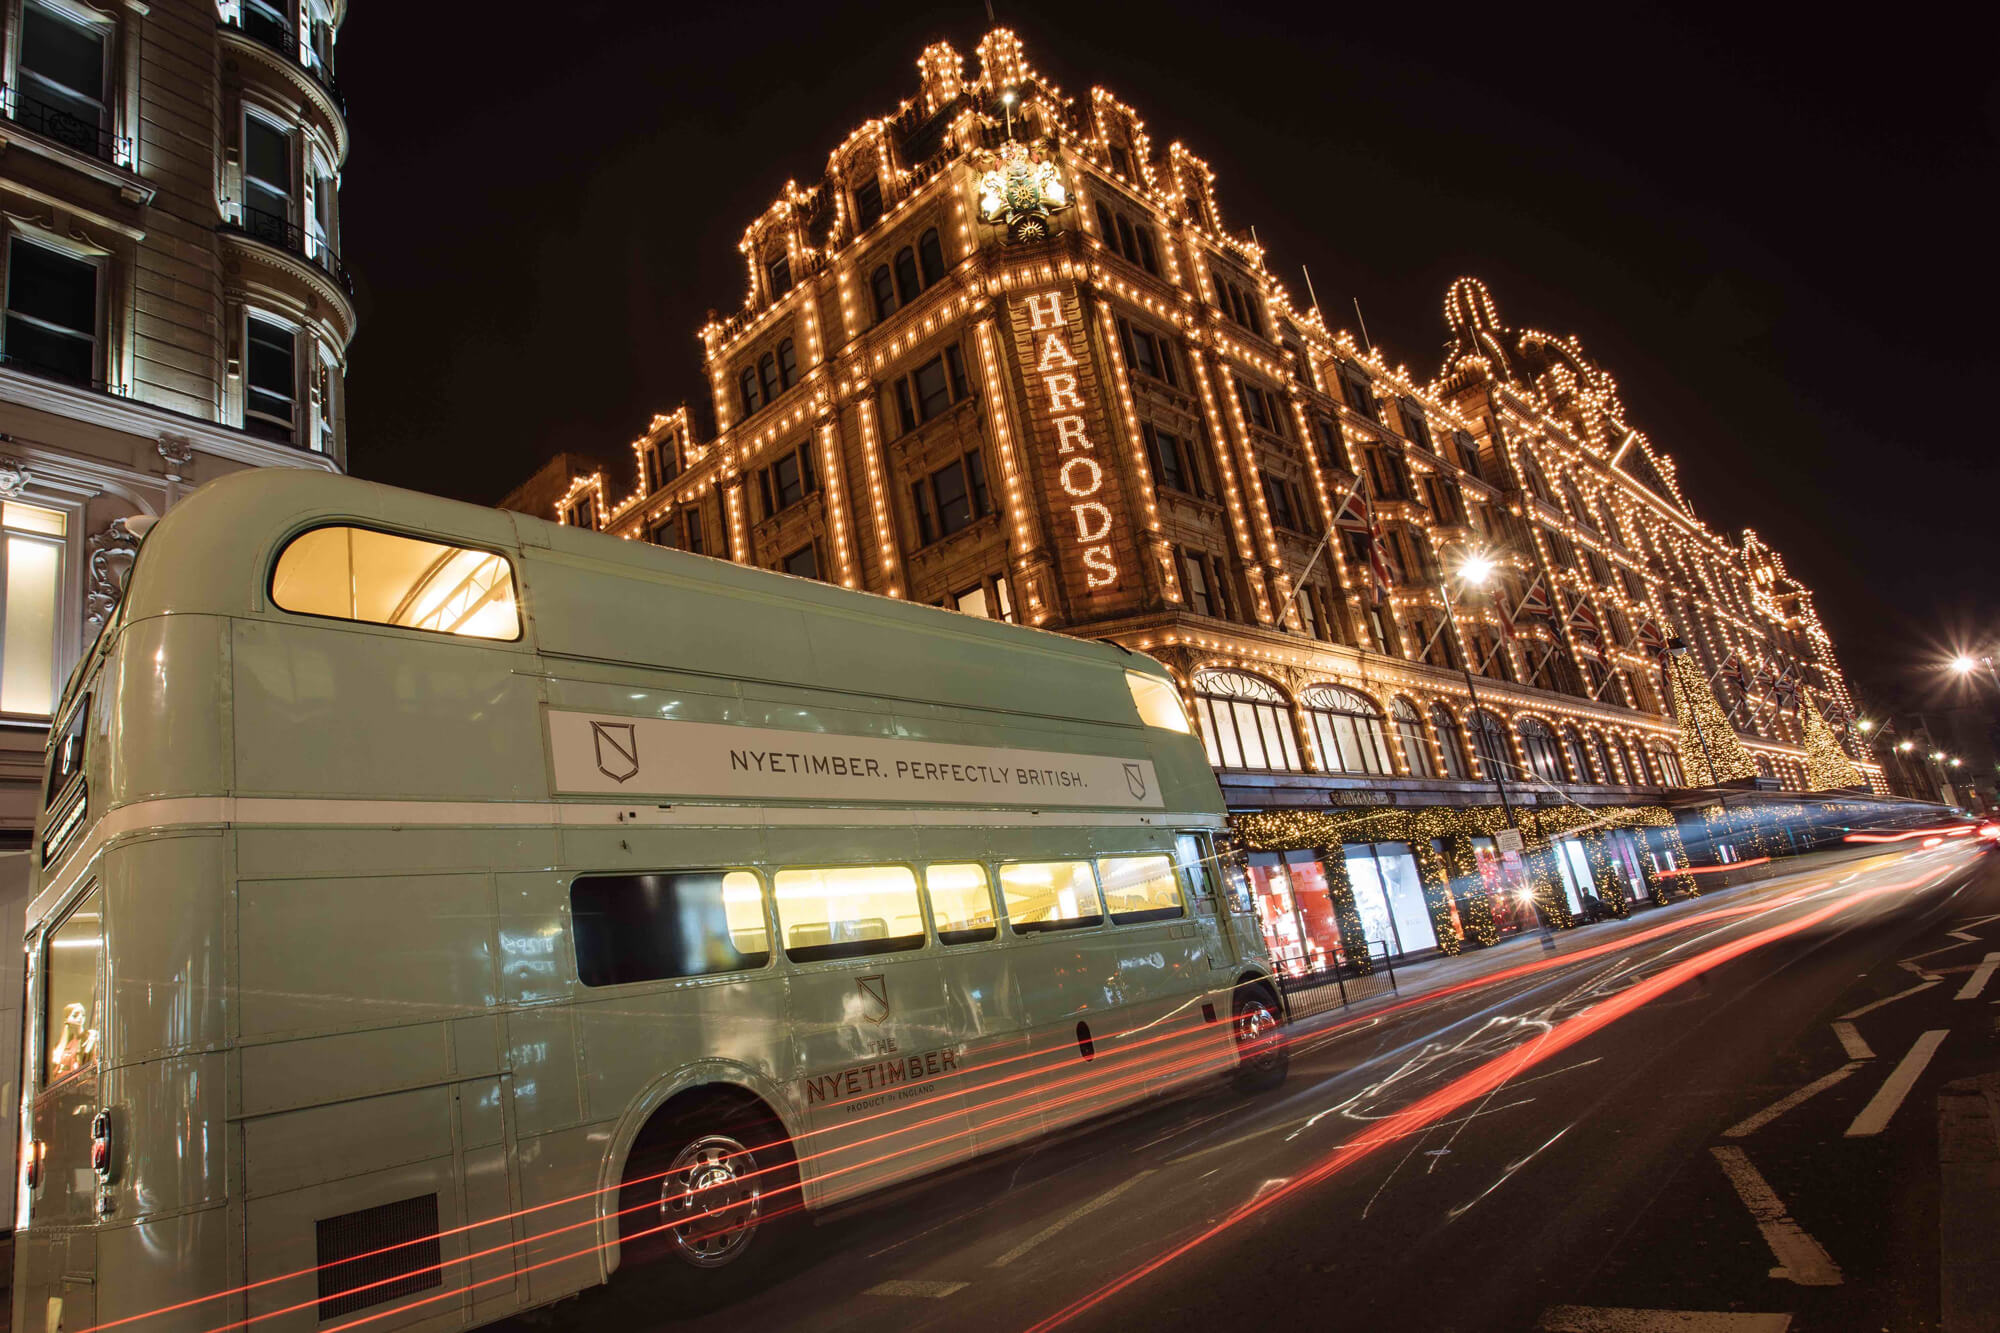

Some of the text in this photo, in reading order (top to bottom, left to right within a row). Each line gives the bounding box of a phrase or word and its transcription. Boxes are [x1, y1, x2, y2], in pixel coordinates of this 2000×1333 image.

[1024, 291, 1118, 588] HARRODS
[730, 749, 1088, 787] NYETIMBER. PERFECTLY BRITISH.
[867, 1038, 897, 1054] THE
[806, 1048, 957, 1104] NYETIMBER
[847, 1095, 886, 1113] PRODUCT
[898, 1084, 935, 1100] ENGLAND
